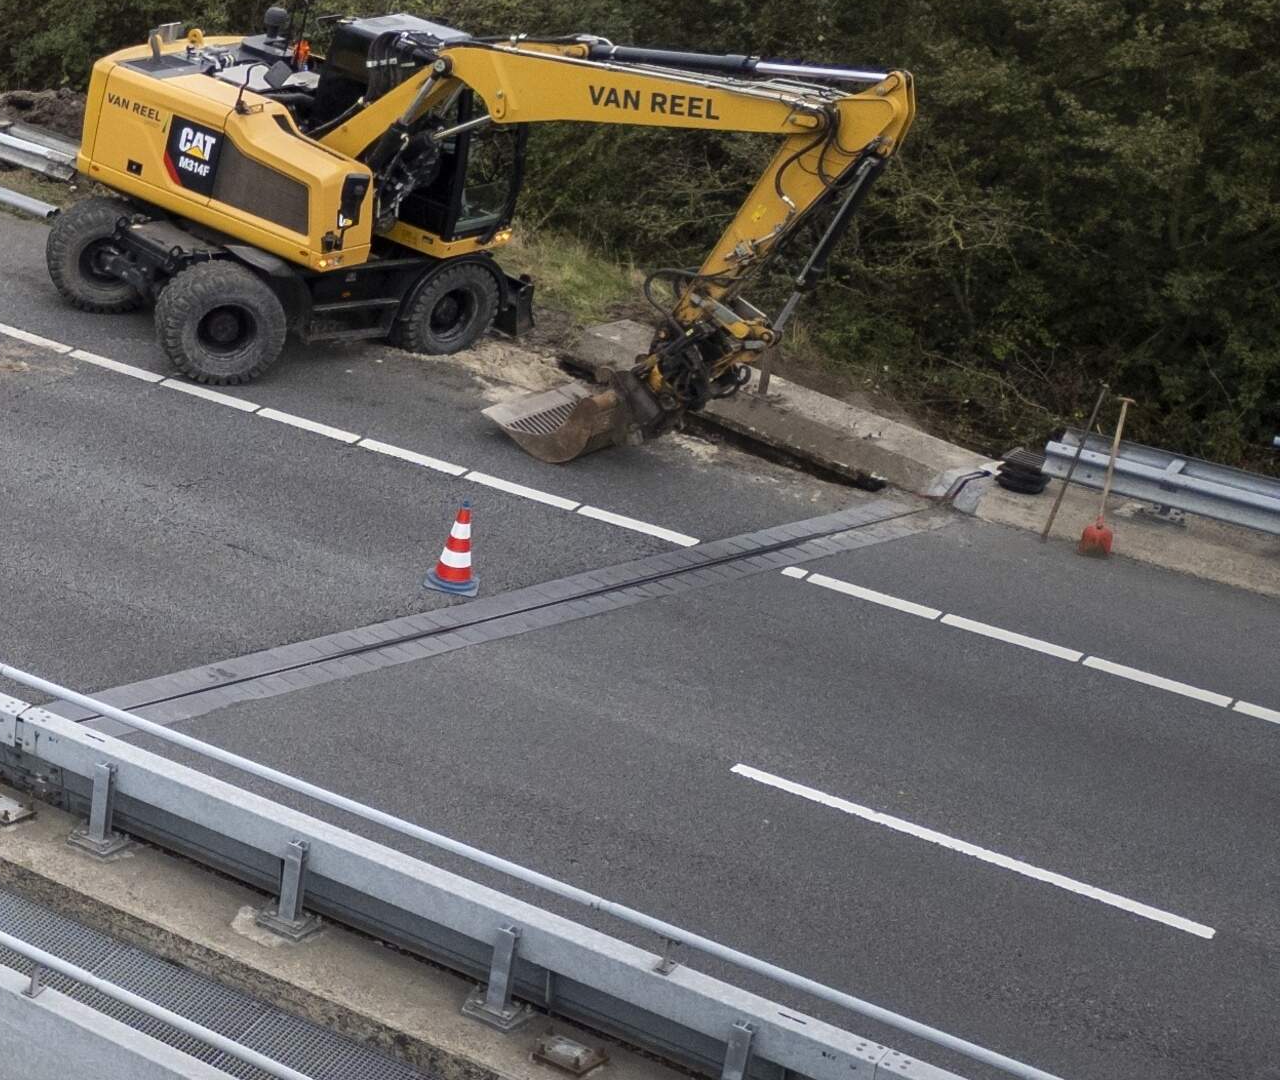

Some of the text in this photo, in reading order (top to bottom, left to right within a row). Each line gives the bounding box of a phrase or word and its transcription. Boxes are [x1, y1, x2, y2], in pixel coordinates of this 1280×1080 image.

[108, 93, 162, 122] VAN REEL
[589, 85, 720, 120] VAN REEL
[178, 127, 216, 161] CAT
[178, 156, 210, 177] M314F
